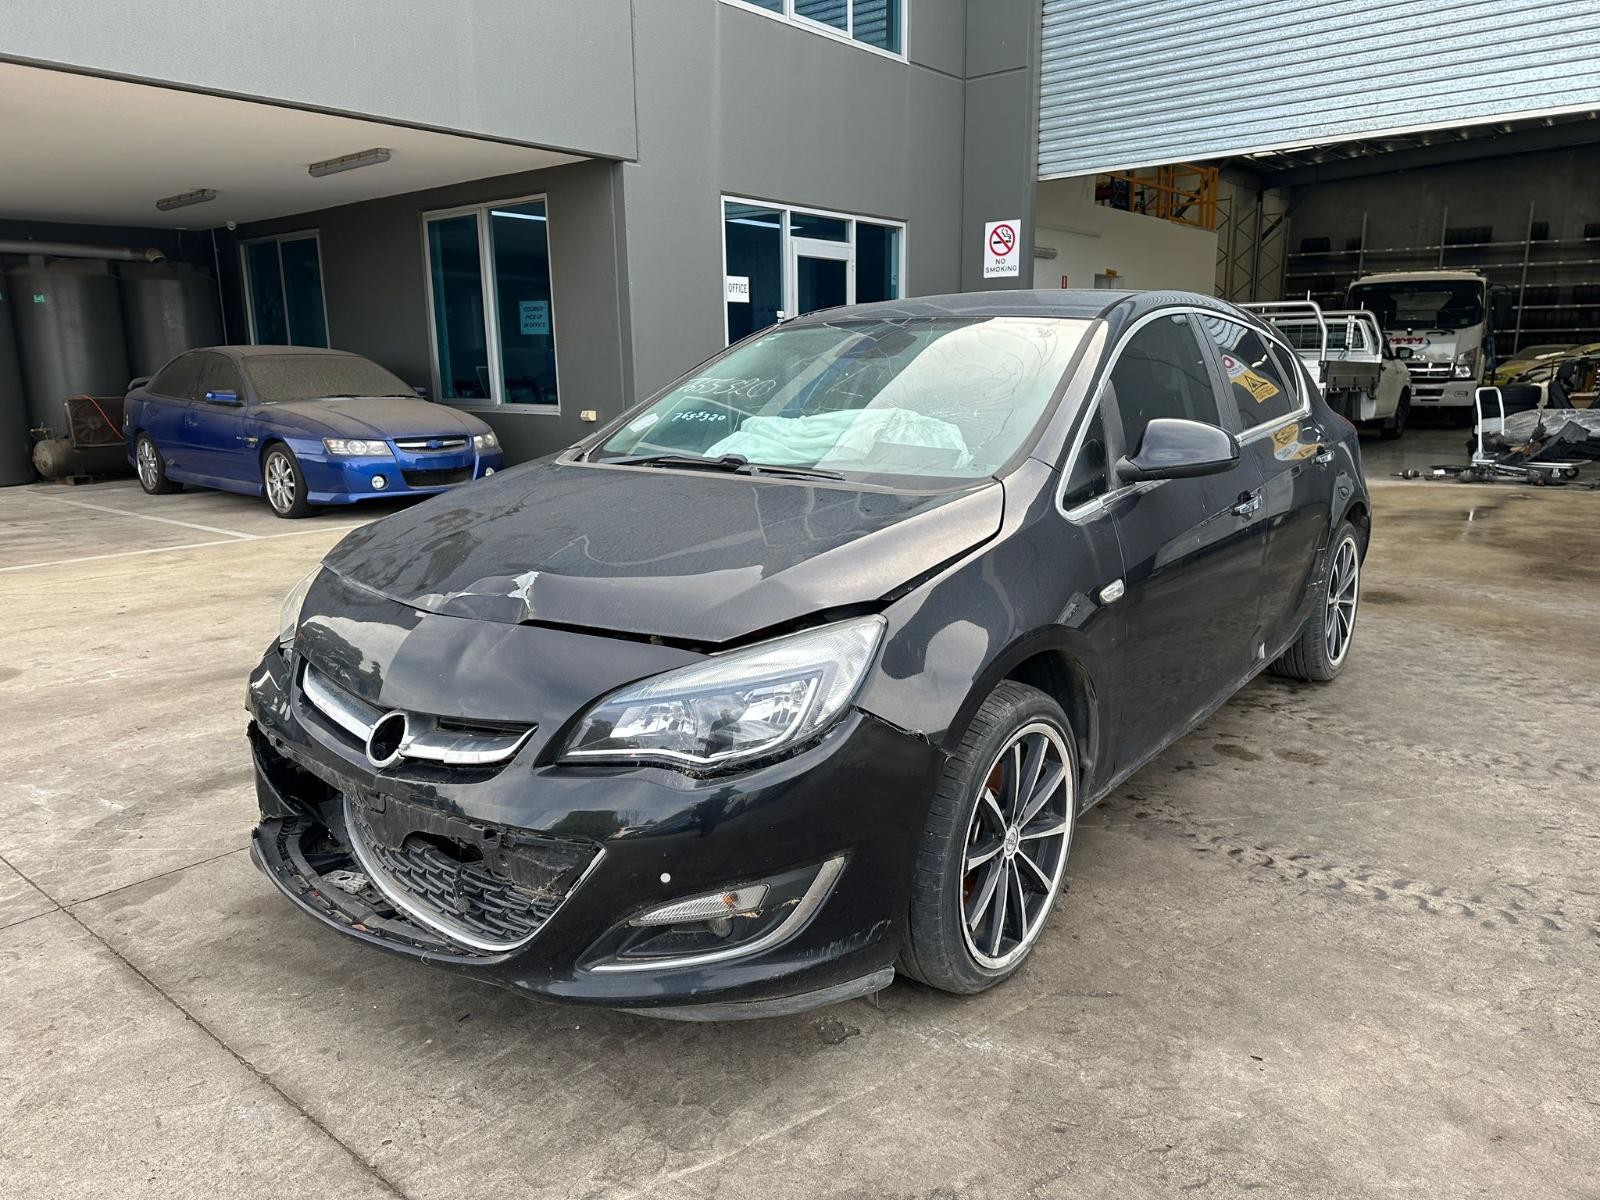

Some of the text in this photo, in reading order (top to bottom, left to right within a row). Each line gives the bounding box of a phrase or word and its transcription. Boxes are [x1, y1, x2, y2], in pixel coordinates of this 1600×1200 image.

[985, 265, 1018, 273] SMOKING
[728, 282, 748, 294] OFFICE
[671, 410, 727, 422] 7655320
